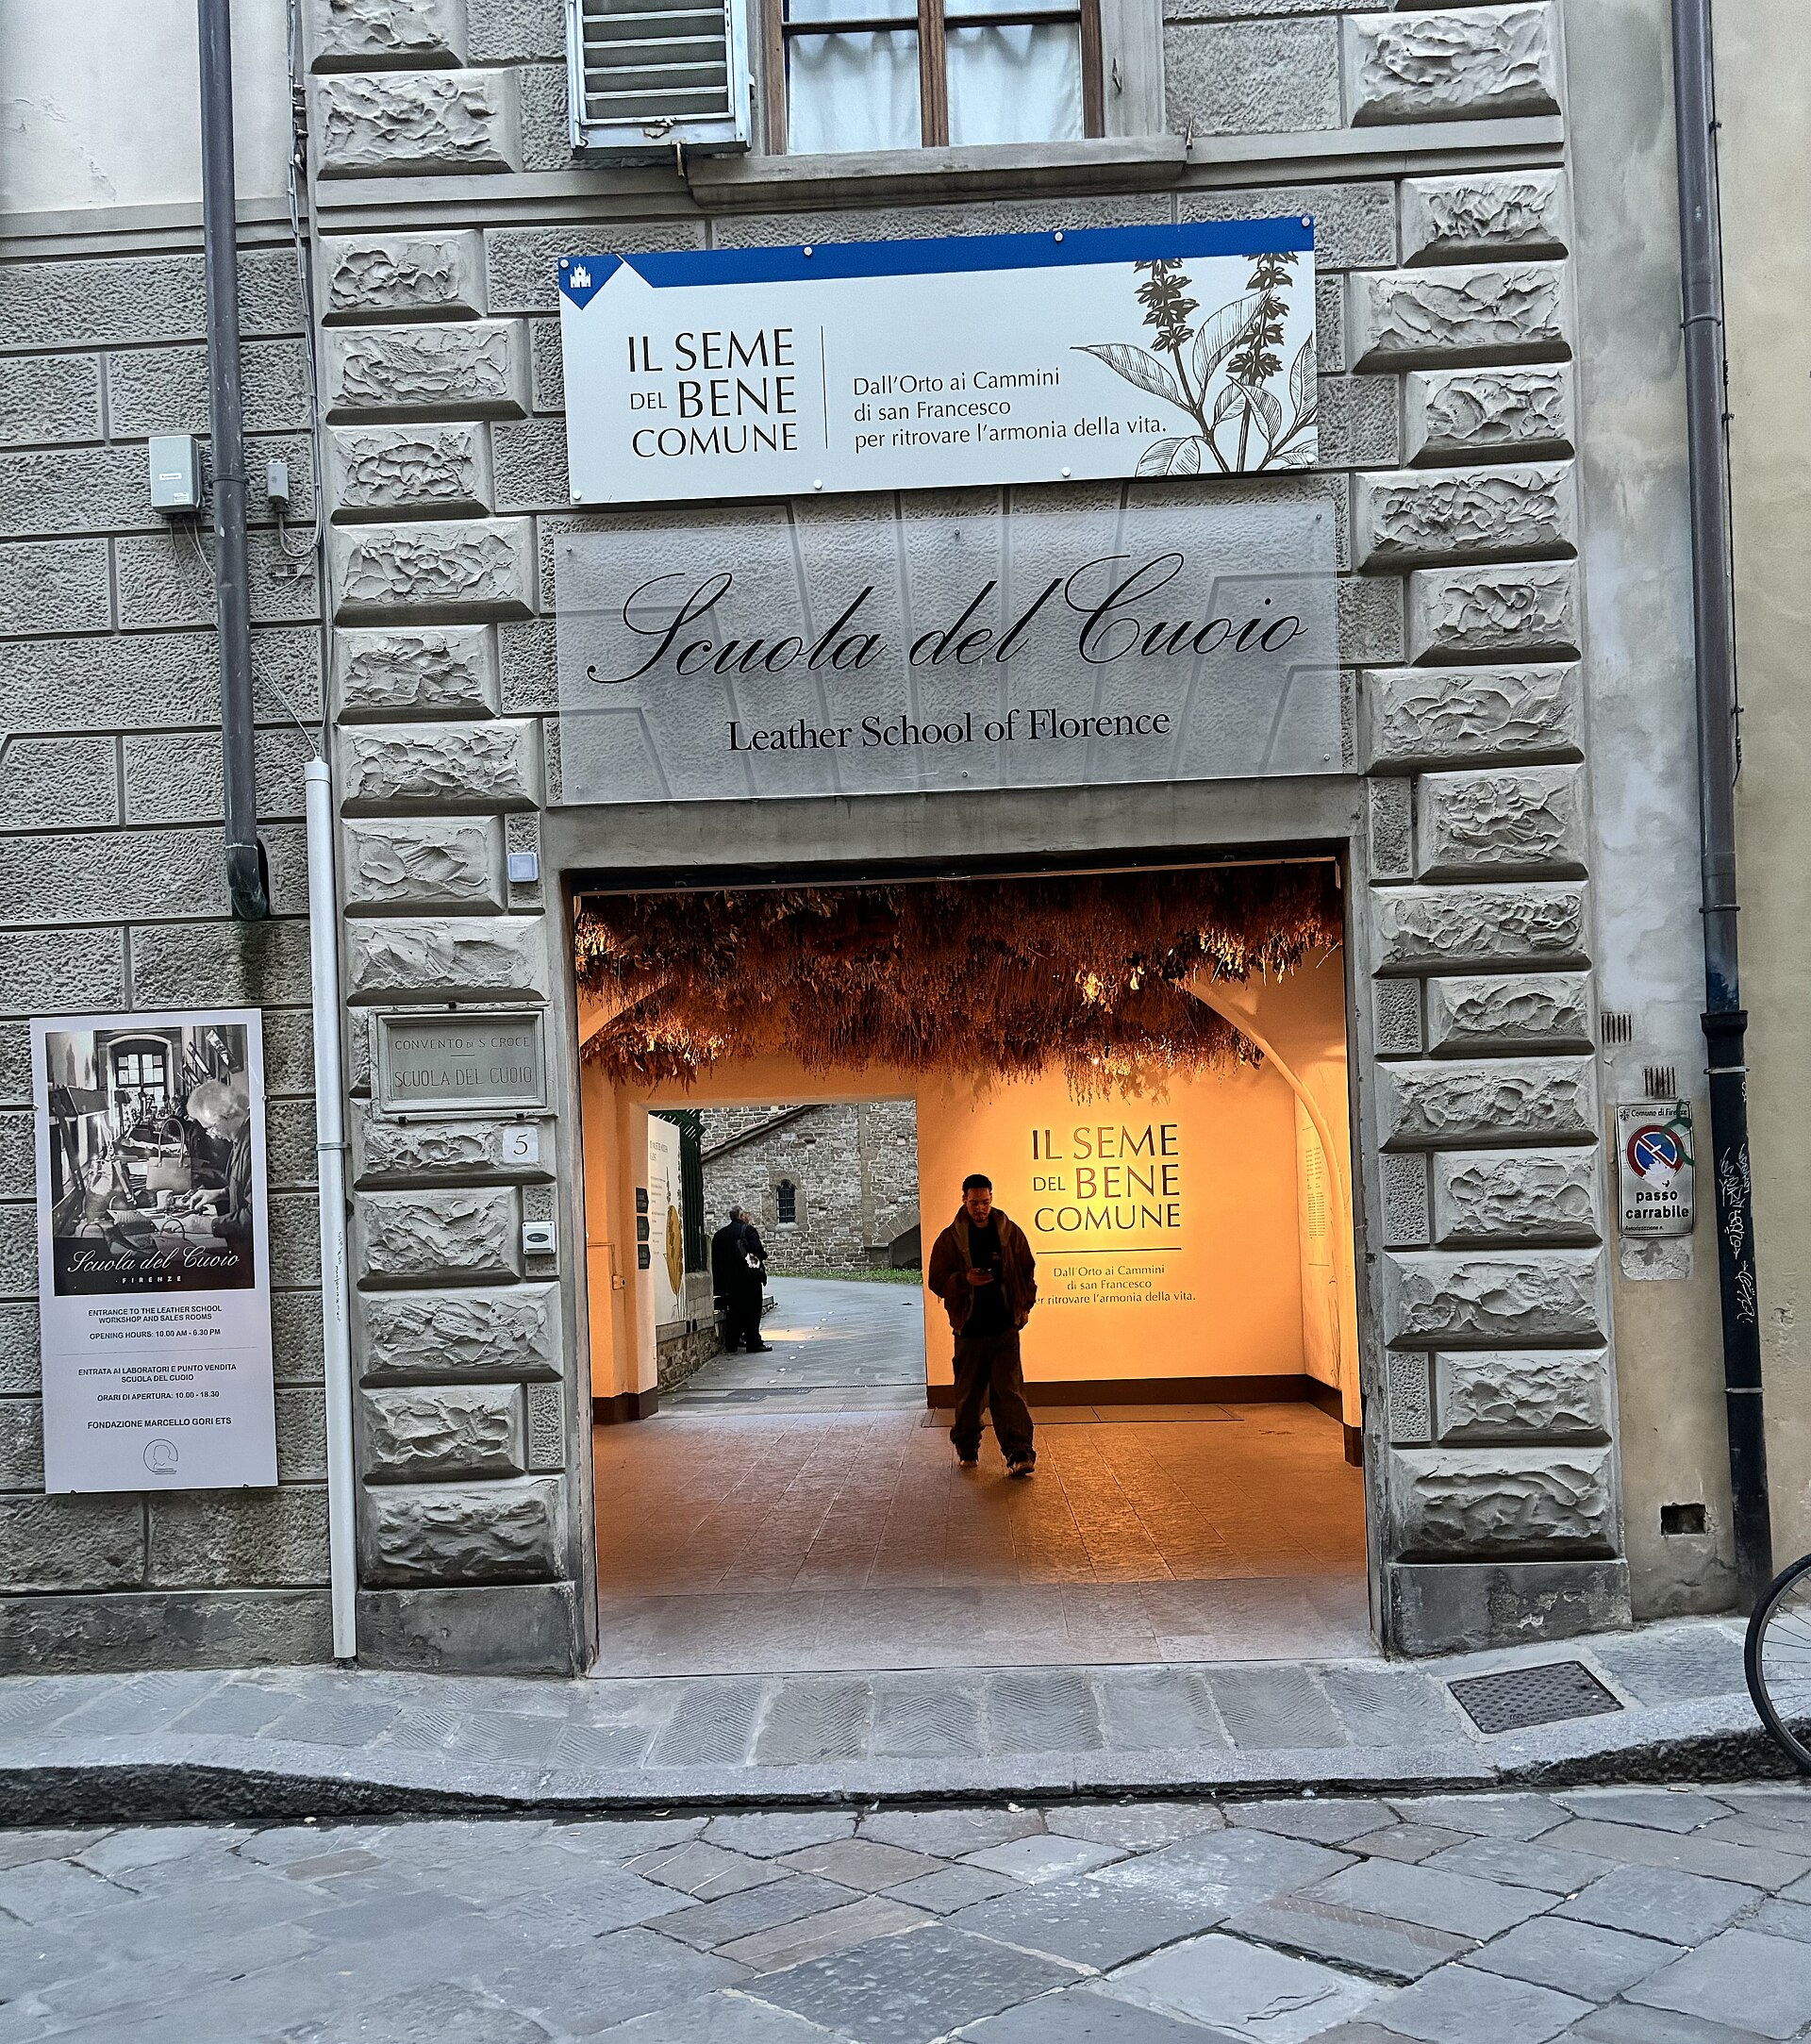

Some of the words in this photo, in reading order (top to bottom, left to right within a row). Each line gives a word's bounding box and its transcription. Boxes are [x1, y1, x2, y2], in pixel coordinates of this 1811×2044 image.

[628, 334, 671, 374] IL
[673, 327, 796, 373] SEME
[949, 370, 966, 392] ai
[972, 366, 1061, 391] Cammini
[629, 391, 669, 412] DEL
[677, 375, 798, 421] BENE
[854, 401, 871, 422] di
[877, 404, 910, 420] san
[917, 397, 1011, 419] Francesco
[631, 423, 799, 458] COMUNE
[854, 435, 885, 454] per
[890, 424, 971, 447] ritrovare
[1072, 416, 1121, 440] della
[1126, 415, 1168, 437] vita.
[587, 571, 887, 684] Scuola
[908, 580, 1064, 670] del
[1064, 552, 1309, 666] Cuoio
[729, 719, 853, 753] Leather
[861, 715, 973, 746] School
[985, 710, 1016, 742] of
[1028, 708, 1171, 741] Florence
[394, 1039, 463, 1051] CONVENTO
[490, 1037, 530, 1048] CROCE
[394, 1069, 451, 1088] SCUOLA
[456, 1068, 484, 1086] DEL
[490, 1066, 532, 1085] CUOIO
[1657, 1107, 1665, 1117] di
[512, 1133, 529, 1156] 5
[1032, 1129, 1062, 1160] IL
[1072, 1123, 1179, 1159] SEME
[1033, 1176, 1066, 1192] DEL
[1076, 1164, 1181, 1199] BENE
[1637, 1189, 1678, 1204] passo
[1034, 1204, 1181, 1232] COMUNE
[1625, 1205, 1689, 1220] carrabile
[67, 1250, 136, 1272] Scuola
[140, 1247, 179, 1270] del
[183, 1246, 241, 1268] Cuoio
[1105, 1265, 1115, 1276] ai
[1118, 1264, 1165, 1276] Cammini
[122, 1275, 182, 1284] FIRENZE
[1067, 1279, 1077, 1290] di
[1080, 1280, 1097, 1289] san
[1100, 1278, 1152, 1289] Francesco
[1047, 1292, 1090, 1305] ritrovare
[1145, 1290, 1171, 1303] della
[1173, 1291, 1196, 1302] vita.
[157, 1305, 190, 1314] LEATHER
[191, 1305, 222, 1313] SCHOOL
[98, 1315, 141, 1324] WORKSHOP
[185, 1313, 212, 1321] ROOMS
[90, 1332, 125, 1340] OPENING
[125, 1331, 154, 1339] HOURS:
[78, 1368, 112, 1376] ENTRATA
[122, 1366, 170, 1374] LABORATORI
[177, 1364, 203, 1372] PUNTO
[205, 1363, 237, 1371] VENDITA
[169, 1373, 193, 1382] CUOIO
[131, 1392, 174, 1401] APERTURA:
[88, 1419, 143, 1429] FONDAZIONE
[144, 1418, 190, 1427] MARCELLO
[191, 1417, 213, 1425] GORI
[215, 1417, 231, 1425] ETS
